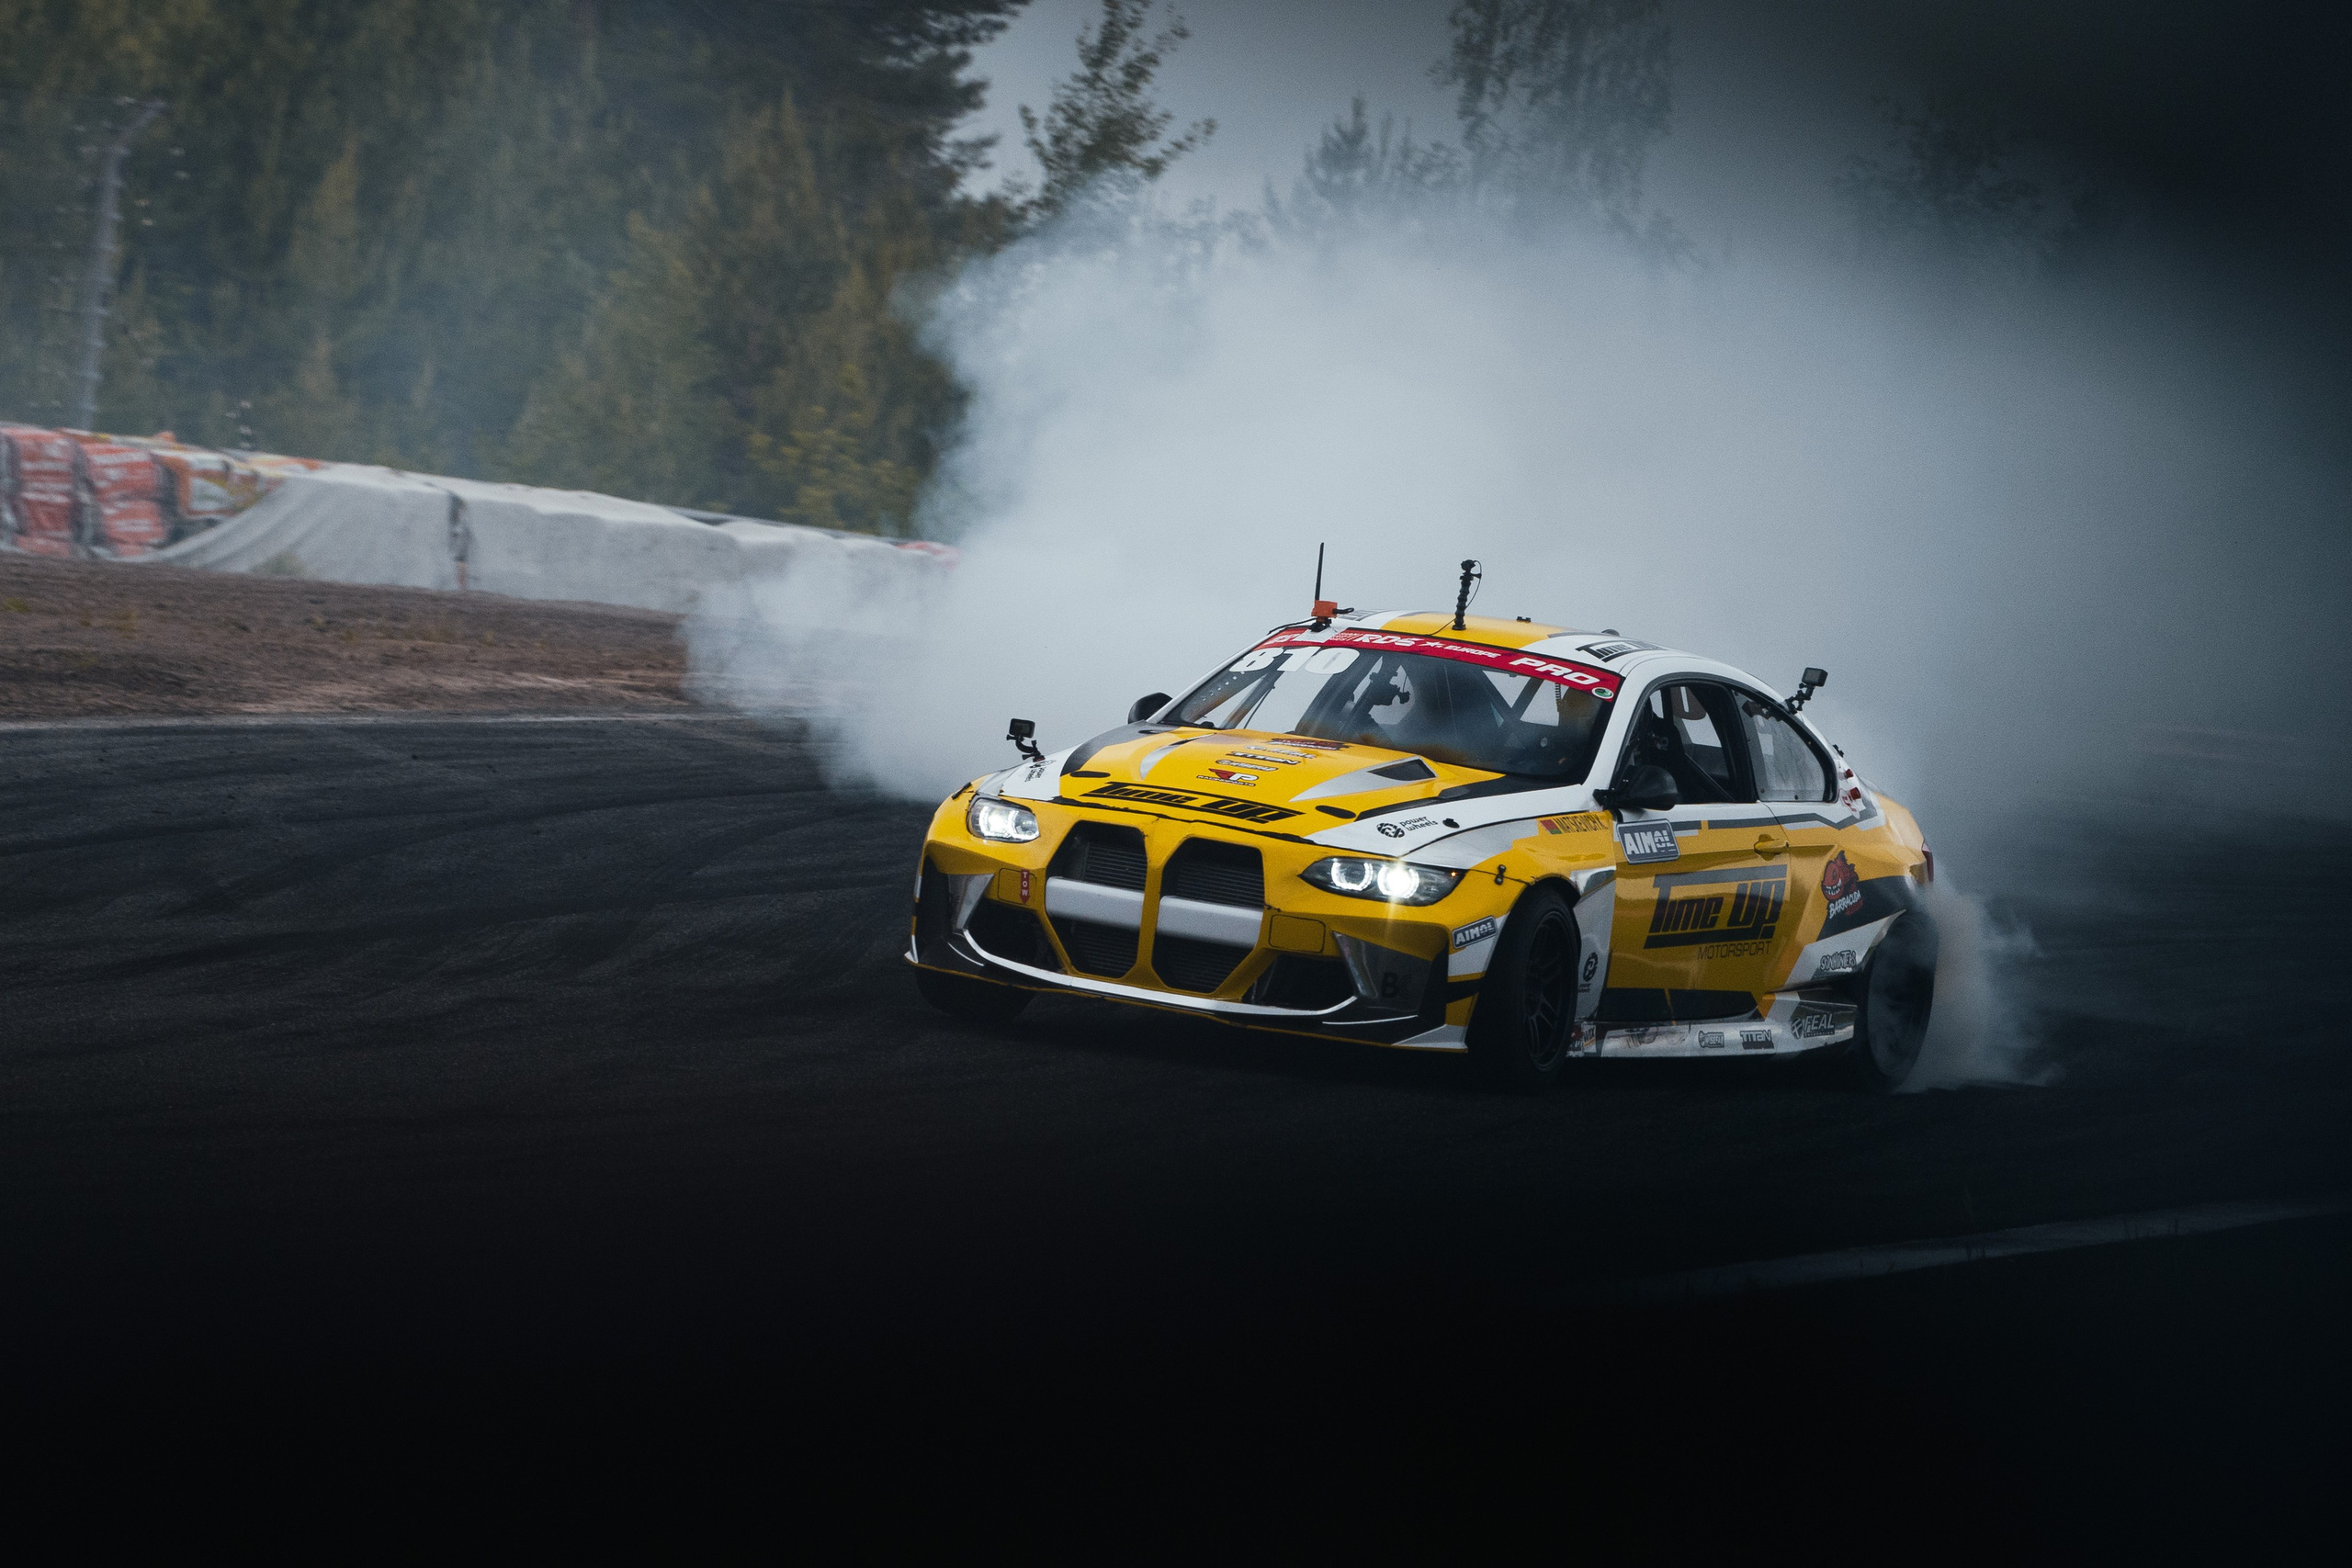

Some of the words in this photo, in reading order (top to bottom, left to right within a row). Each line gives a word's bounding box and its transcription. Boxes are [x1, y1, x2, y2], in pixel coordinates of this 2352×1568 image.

[1229, 646, 1360, 674] 810
[1354, 634, 1424, 647] RDS
[1444, 645, 1501, 659] EUROPE
[1509, 656, 1600, 685] PRO
[1399, 816, 1427, 827] power
[1406, 819, 1439, 831] wheels
[1623, 829, 1675, 855] AIMOL
[1021, 871, 1029, 897] TOW
[1829, 890, 1861, 919] BARRACUDA
[1455, 921, 1495, 945] AIMOL
[1698, 940, 1772, 960] MOTORSPORT
[1804, 1013, 1835, 1032] FEAL
